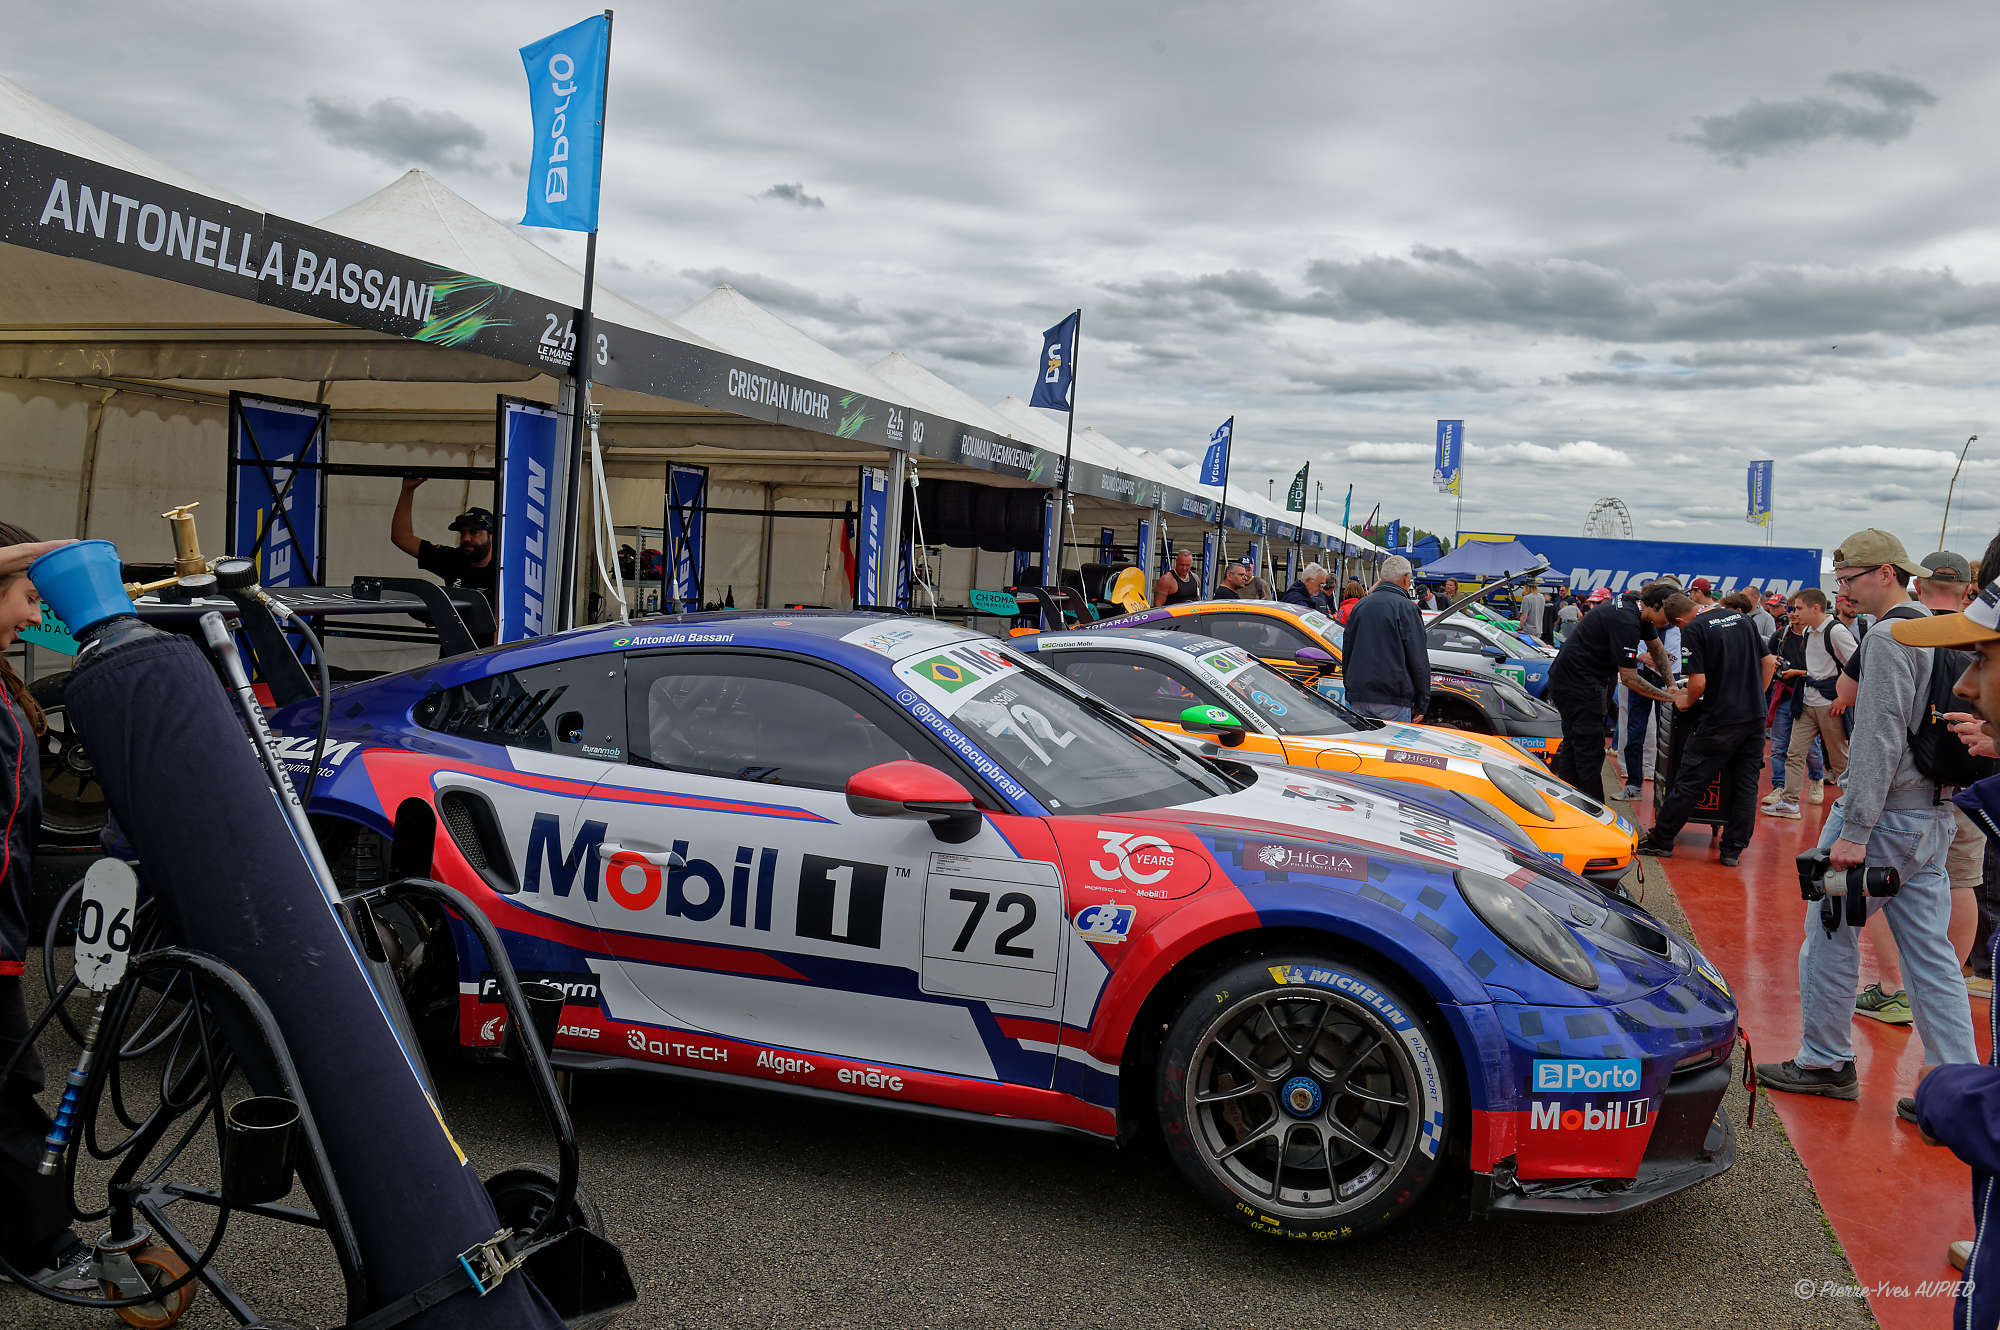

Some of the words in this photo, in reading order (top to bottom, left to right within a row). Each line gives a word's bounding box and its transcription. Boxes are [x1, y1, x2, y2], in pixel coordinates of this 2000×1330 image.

[40, 178, 284, 286] ANTONELLA
[292, 247, 435, 323] BASSANI
[537, 344, 549, 355] LE
[549, 347, 574, 361] MANS
[596, 333, 608, 366] 3
[728, 368, 790, 410] CRISTIAN
[791, 386, 830, 420] MOHR
[913, 420, 924, 443] 80
[523, 455, 547, 640] HELIN
[976, 593, 1015, 605] CHROMA
[630, 634, 686, 647] Antonella
[688, 632, 734, 643] Bassani
[1051, 641, 1075, 649] Cristian
[1210, 677, 1268, 730] @porschecupbrasil
[912, 701, 1026, 802] @porschecupbrasil
[1521, 738, 1545, 747] Porto
[1089, 830, 1174, 885] 30
[1135, 853, 1175, 867] YEARS
[1285, 849, 1353, 869] HÍGIA
[522, 811, 779, 932] Mobil
[1084, 885, 1127, 894] PORSCHE
[1136, 889, 1159, 898] Mobil
[77, 899, 132, 952] 06
[949, 888, 1038, 959] 72
[1076, 905, 1132, 935] CBA
[1309, 969, 1405, 1026] MICHELIN
[557, 1024, 600, 1039] ABOS
[649, 1041, 728, 1063] QITECH
[757, 1051, 804, 1075] Algar
[1411, 1036, 1428, 1067] PILOT
[1425, 1067, 1439, 1102] SPORT
[1567, 1064, 1637, 1089] Porto
[1530, 1101, 1622, 1131] Mobil
